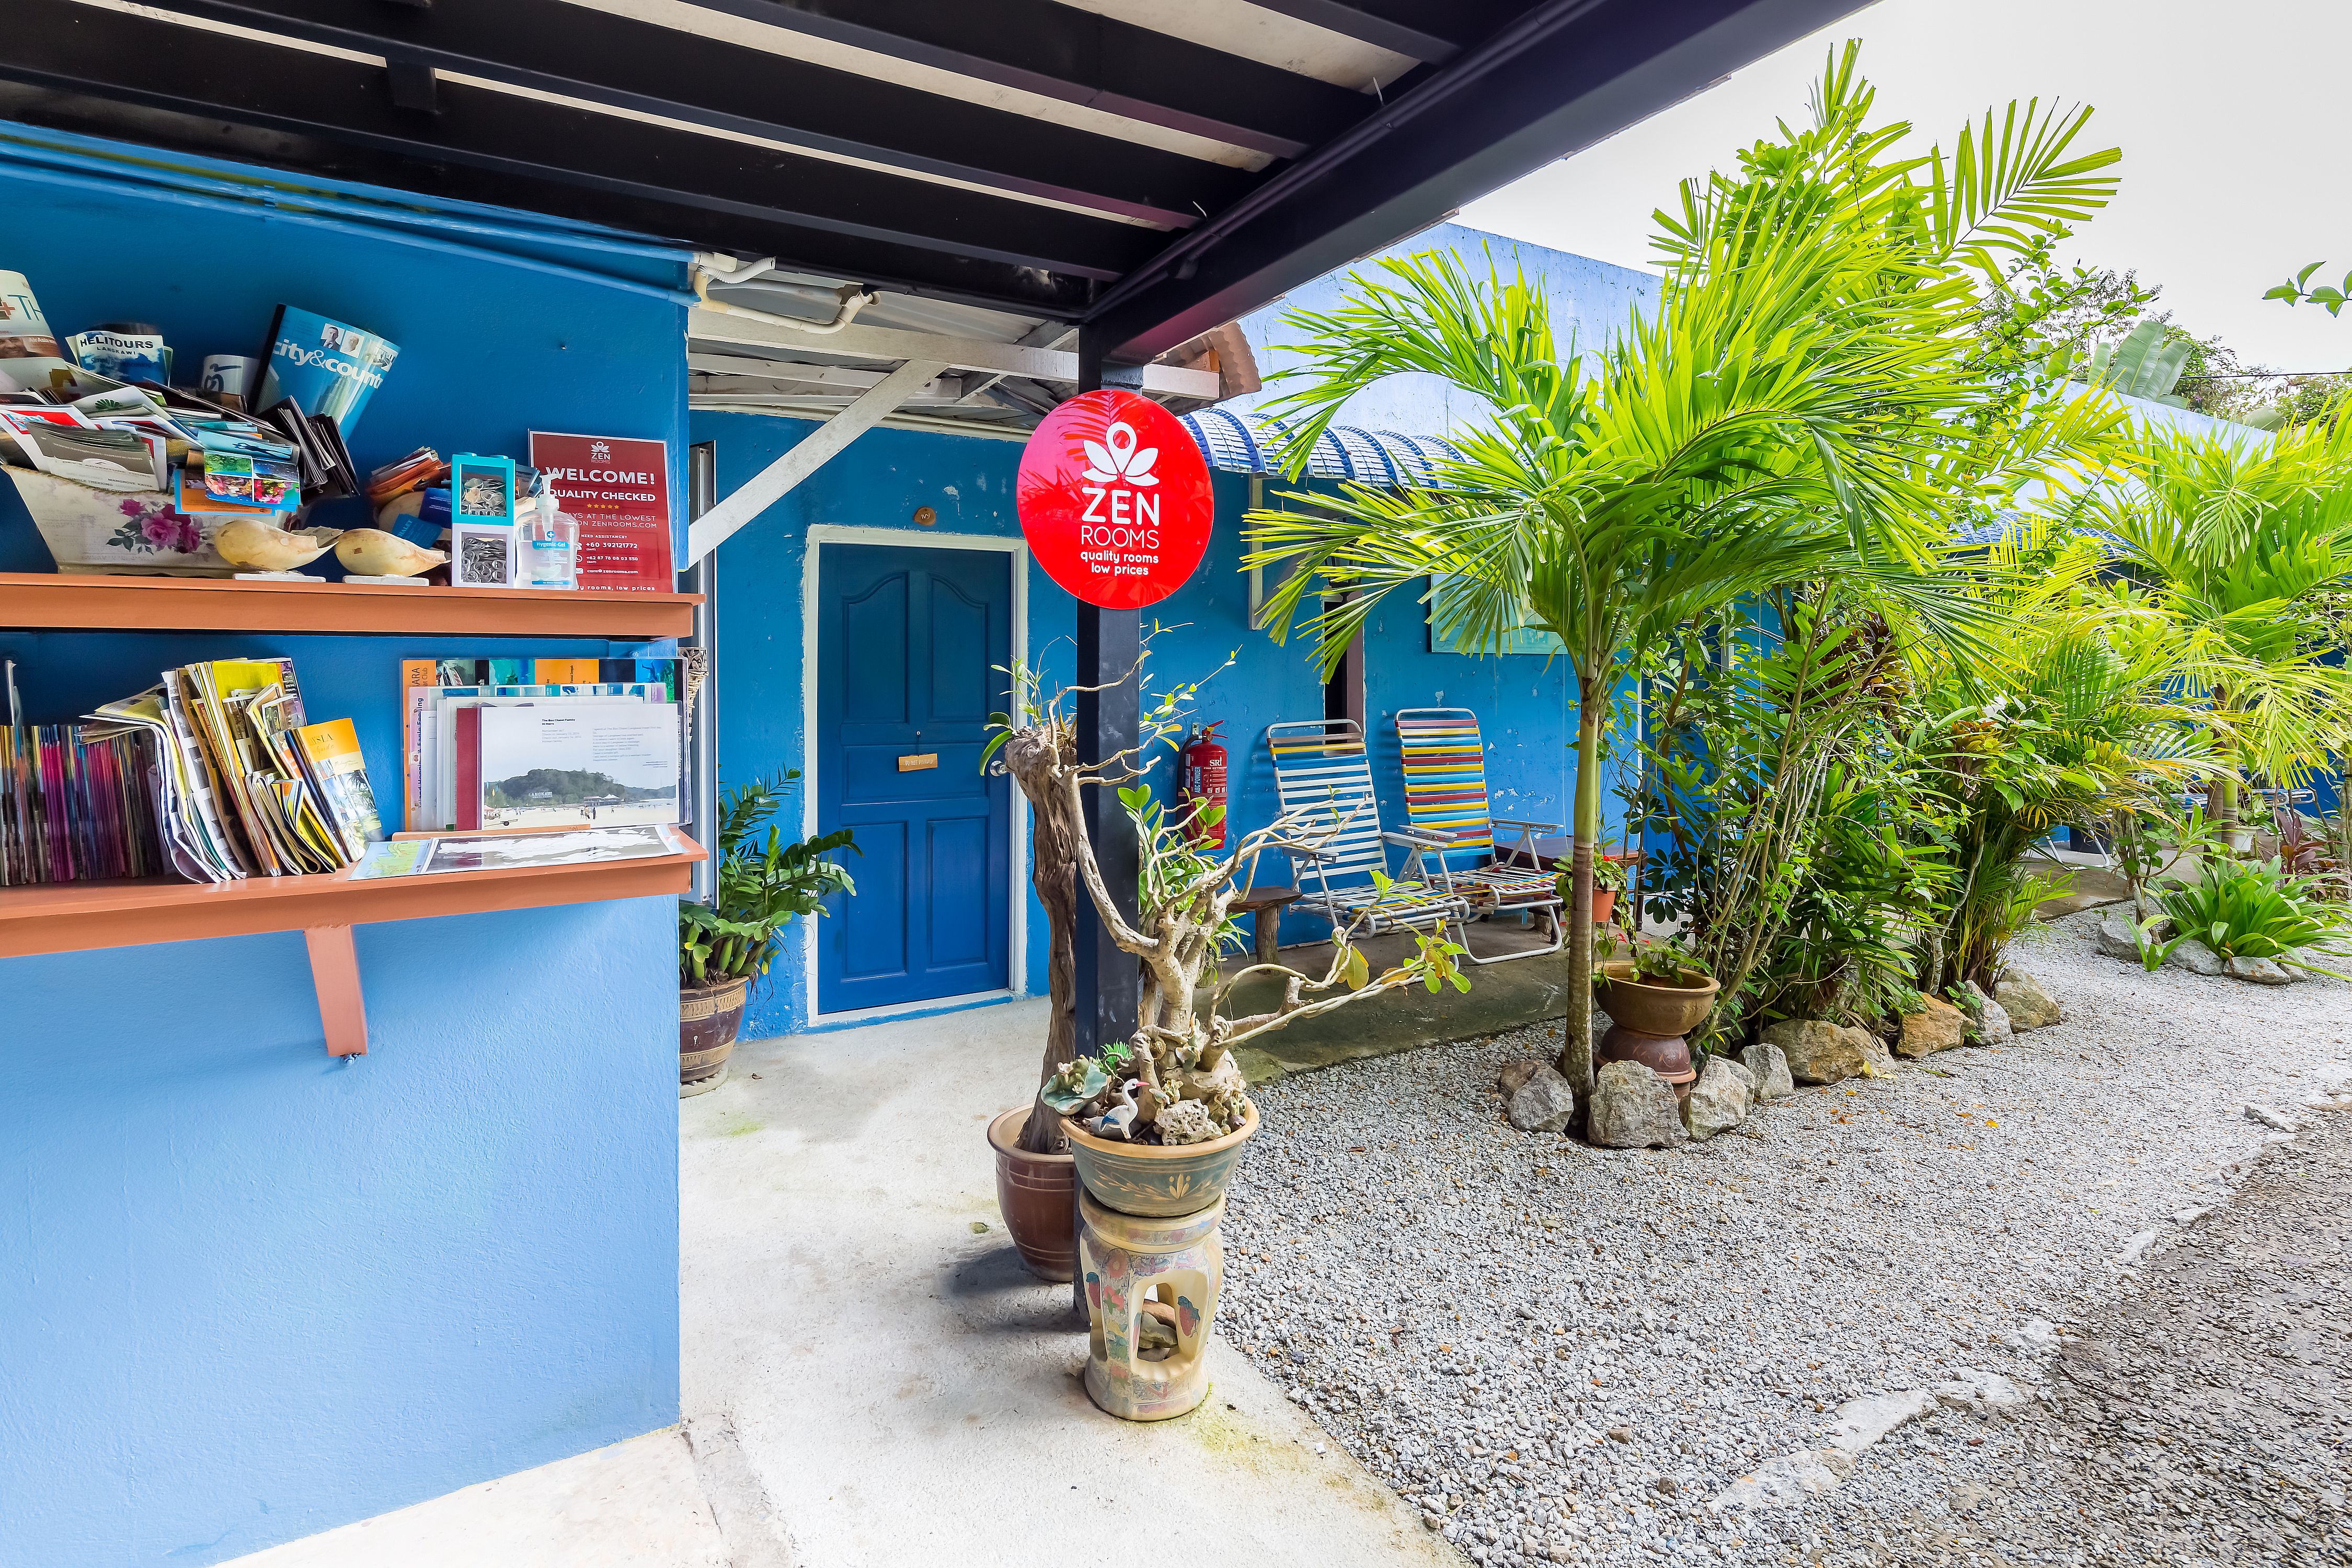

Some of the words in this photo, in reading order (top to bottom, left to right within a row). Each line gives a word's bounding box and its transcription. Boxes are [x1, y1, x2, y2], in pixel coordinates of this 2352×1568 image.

[80, 336, 153, 349] HELITOURS
[97, 347, 136, 355] LANGKAWI
[545, 467, 655, 485] WELCOME!
[549, 489, 598, 499] QUALITY
[602, 491, 656, 502] CHECKED
[1081, 487, 1160, 526] ZEN
[1081, 525, 1160, 549] ROOMS
[1080, 550, 1120, 563] quality
[1123, 554, 1159, 564] rooms
[1091, 562, 1110, 574] low
[1114, 564, 1149, 577] prices
[1209, 757, 1222, 766] SRI
